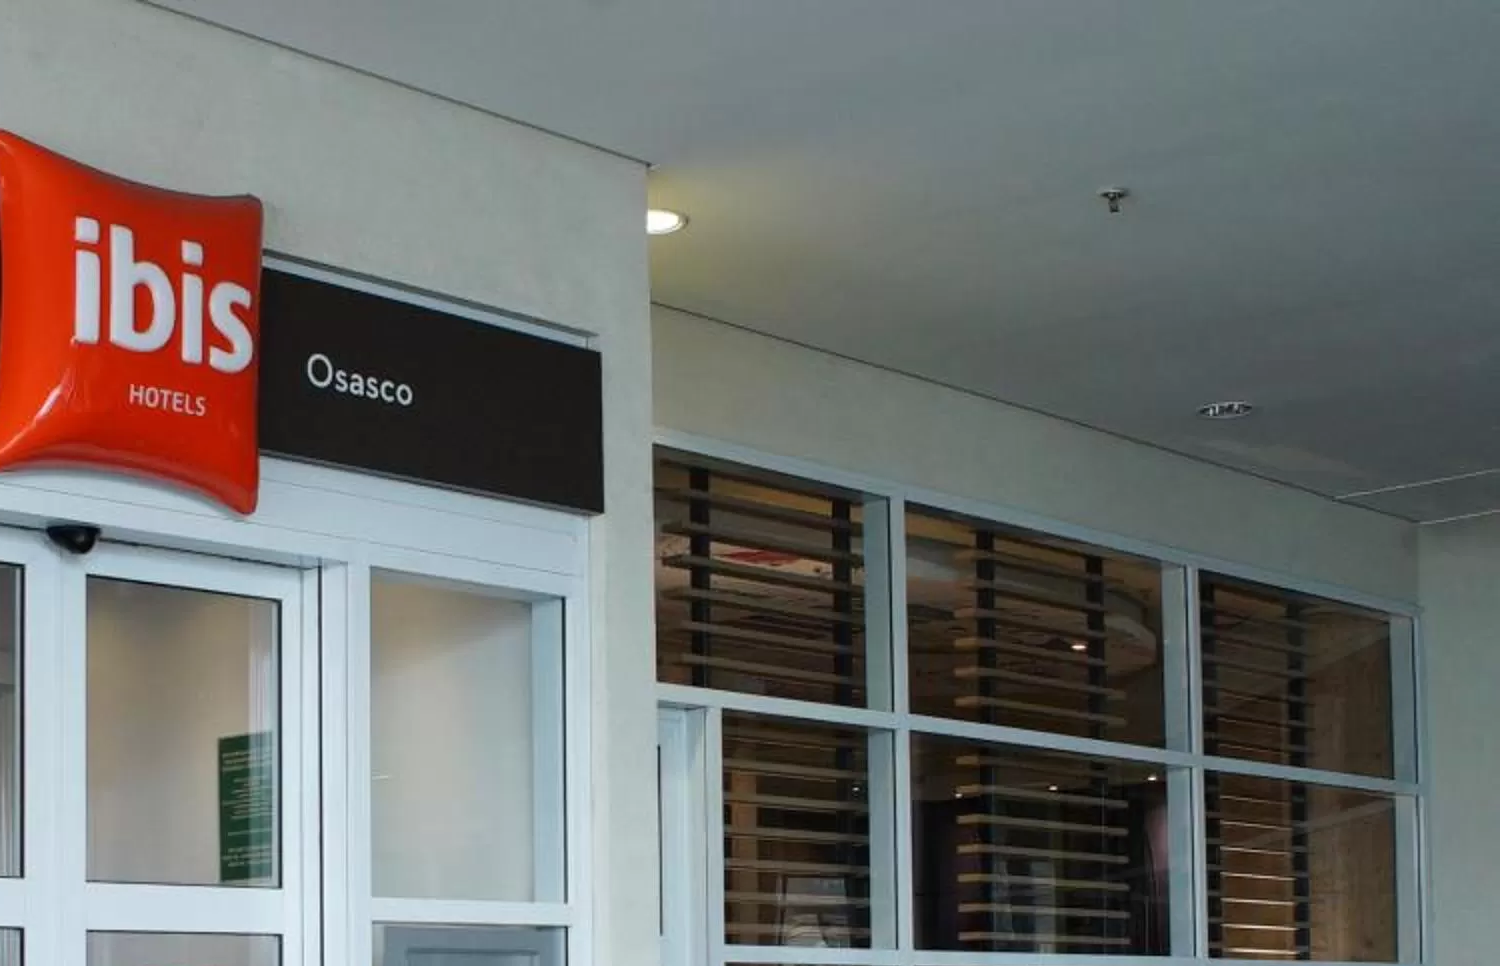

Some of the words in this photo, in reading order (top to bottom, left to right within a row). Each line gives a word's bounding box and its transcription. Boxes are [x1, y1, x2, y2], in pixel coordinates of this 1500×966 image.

[75, 216, 254, 373] ibis
[129, 384, 206, 417] HOTELS
[306, 353, 413, 405] Osasco
